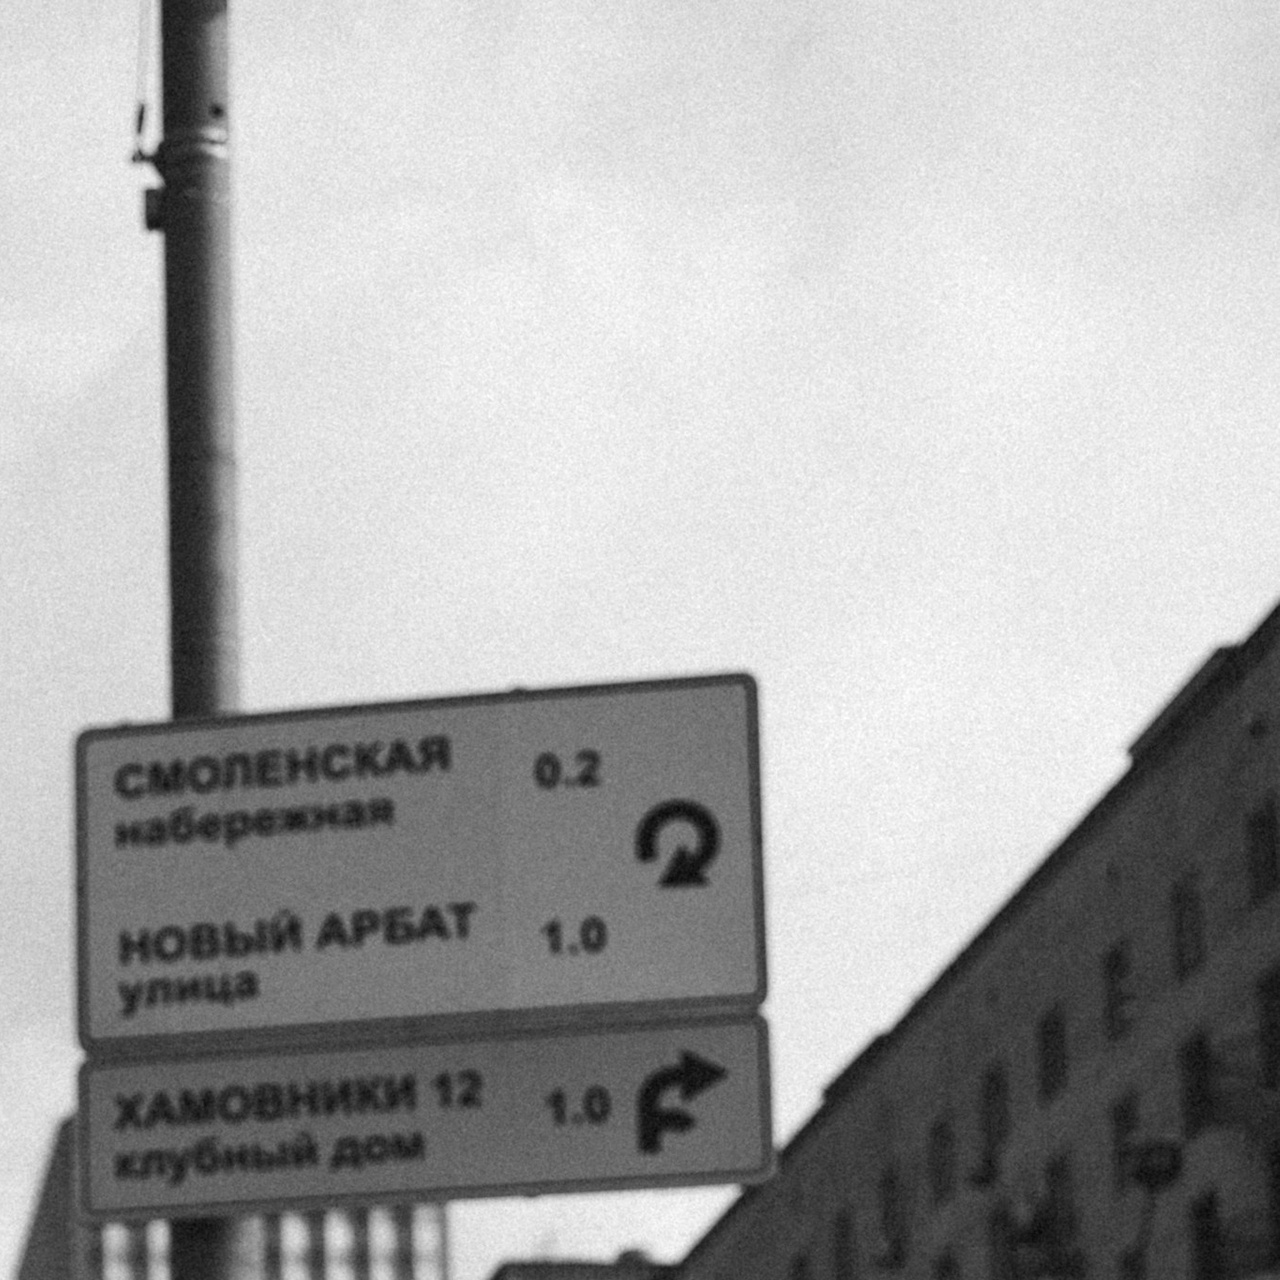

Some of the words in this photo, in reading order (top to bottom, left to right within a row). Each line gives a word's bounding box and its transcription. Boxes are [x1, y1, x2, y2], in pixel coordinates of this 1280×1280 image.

[114, 735, 452, 800] СМОЛЕНСКАЯ
[532, 749, 602, 790] 0.2
[115, 797, 396, 848] набережная
[118, 909, 303, 966] НОВЫЙ
[316, 901, 476, 950] АРБАТ
[542, 915, 608, 955] 1.0
[117, 970, 260, 1018] улица
[114, 1072, 418, 1131] ХАМОВНИКИ
[431, 1068, 484, 1109] 12
[545, 1084, 613, 1126] 1.0
[114, 1131, 320, 1187] клубный
[329, 1131, 426, 1171] дом
